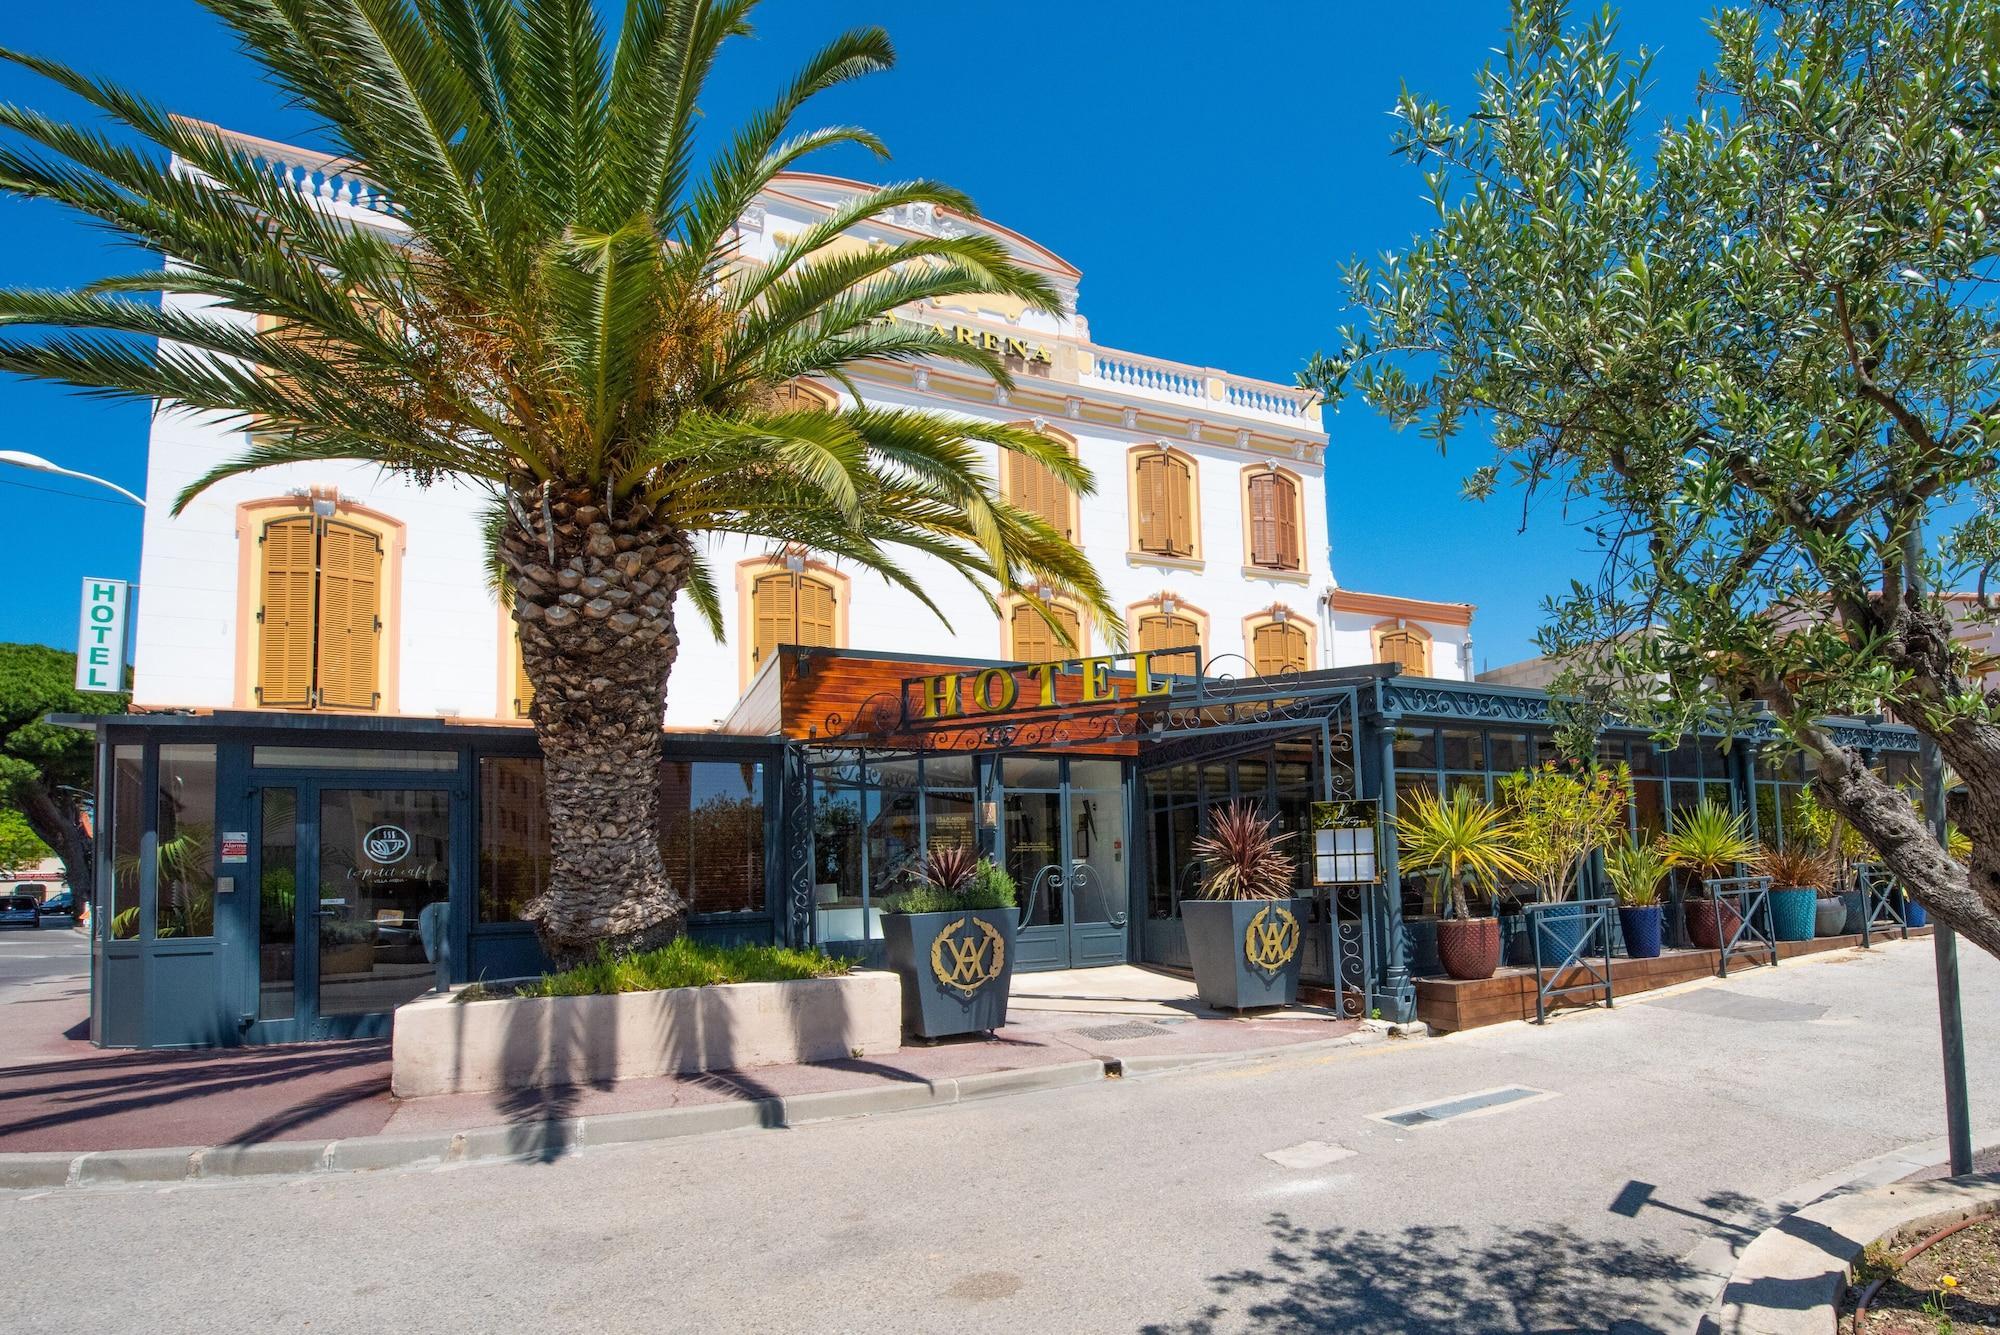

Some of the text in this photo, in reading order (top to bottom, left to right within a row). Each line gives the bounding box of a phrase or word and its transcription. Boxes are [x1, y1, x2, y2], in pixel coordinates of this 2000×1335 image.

[929, 319, 1052, 364] ARENA
[88, 583, 116, 687] HOTEL
[921, 652, 1174, 719] HOTEL
